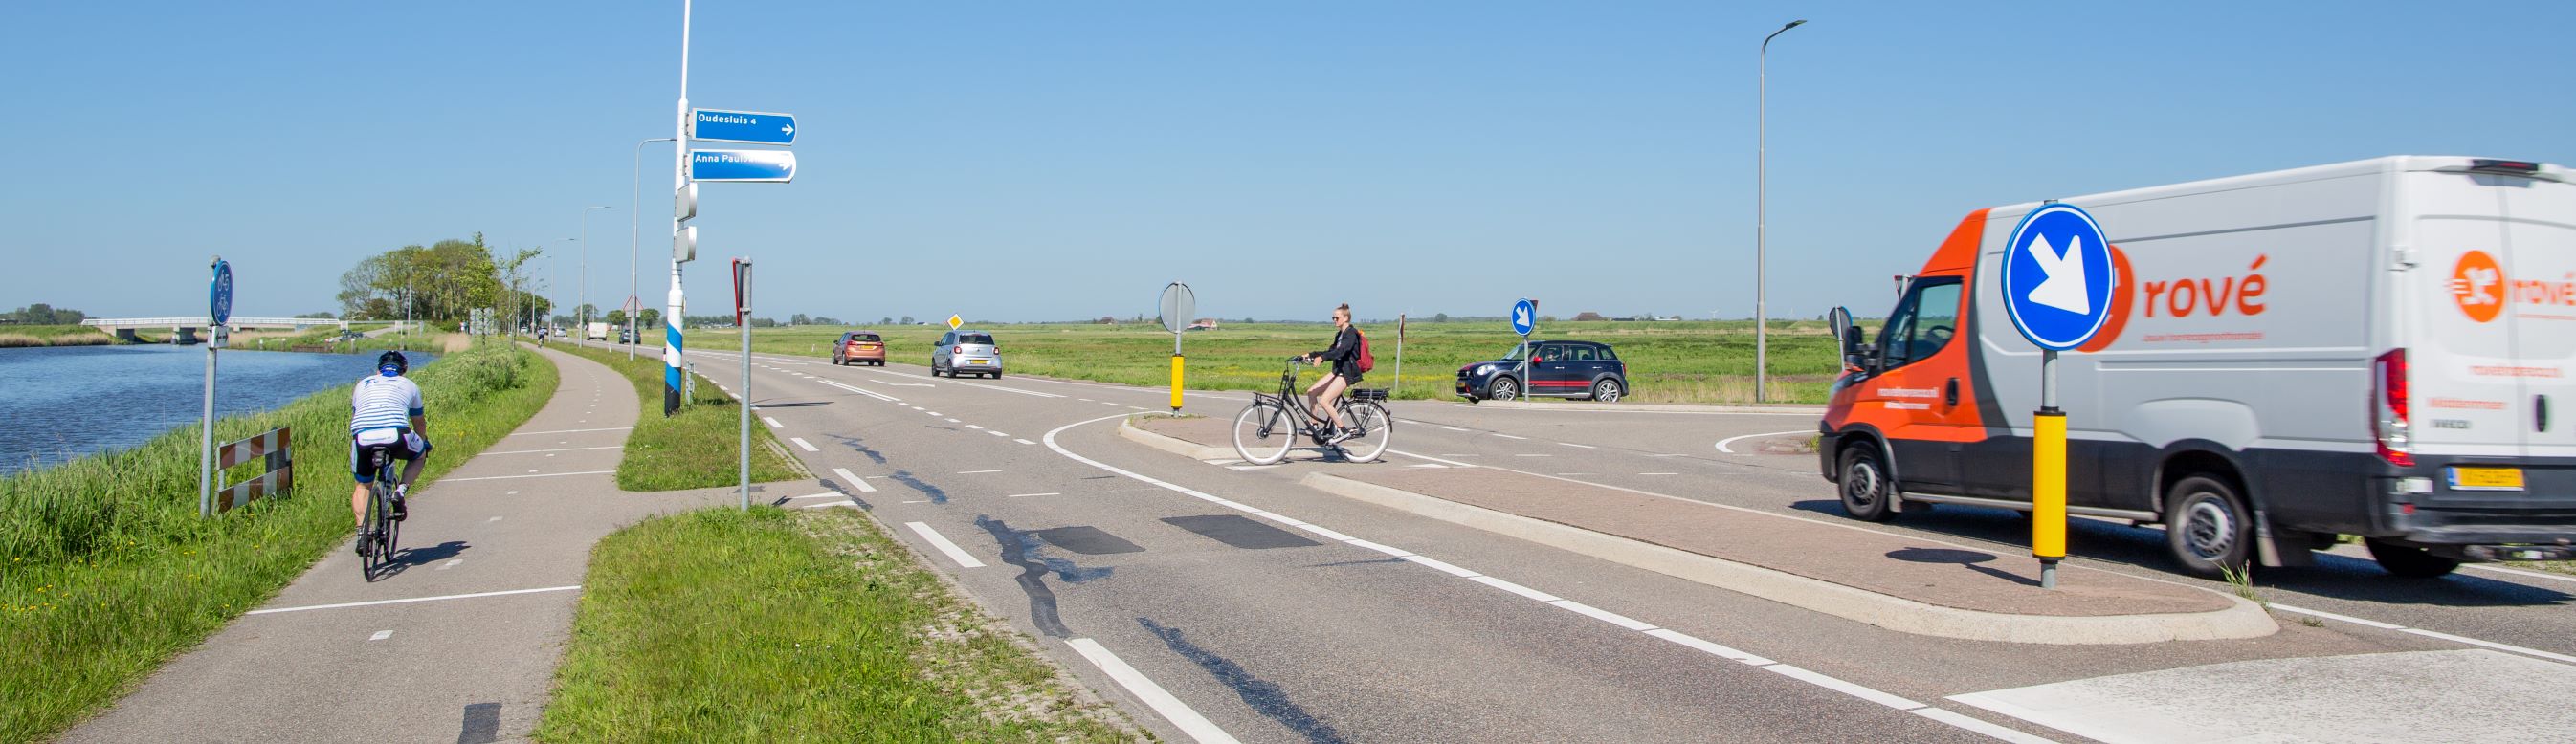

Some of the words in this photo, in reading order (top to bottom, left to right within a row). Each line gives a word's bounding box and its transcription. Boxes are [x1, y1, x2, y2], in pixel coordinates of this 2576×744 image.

[698, 113, 748, 125] Oudesluis
[695, 154, 720, 163] Anna
[2143, 252, 2268, 318] rové
